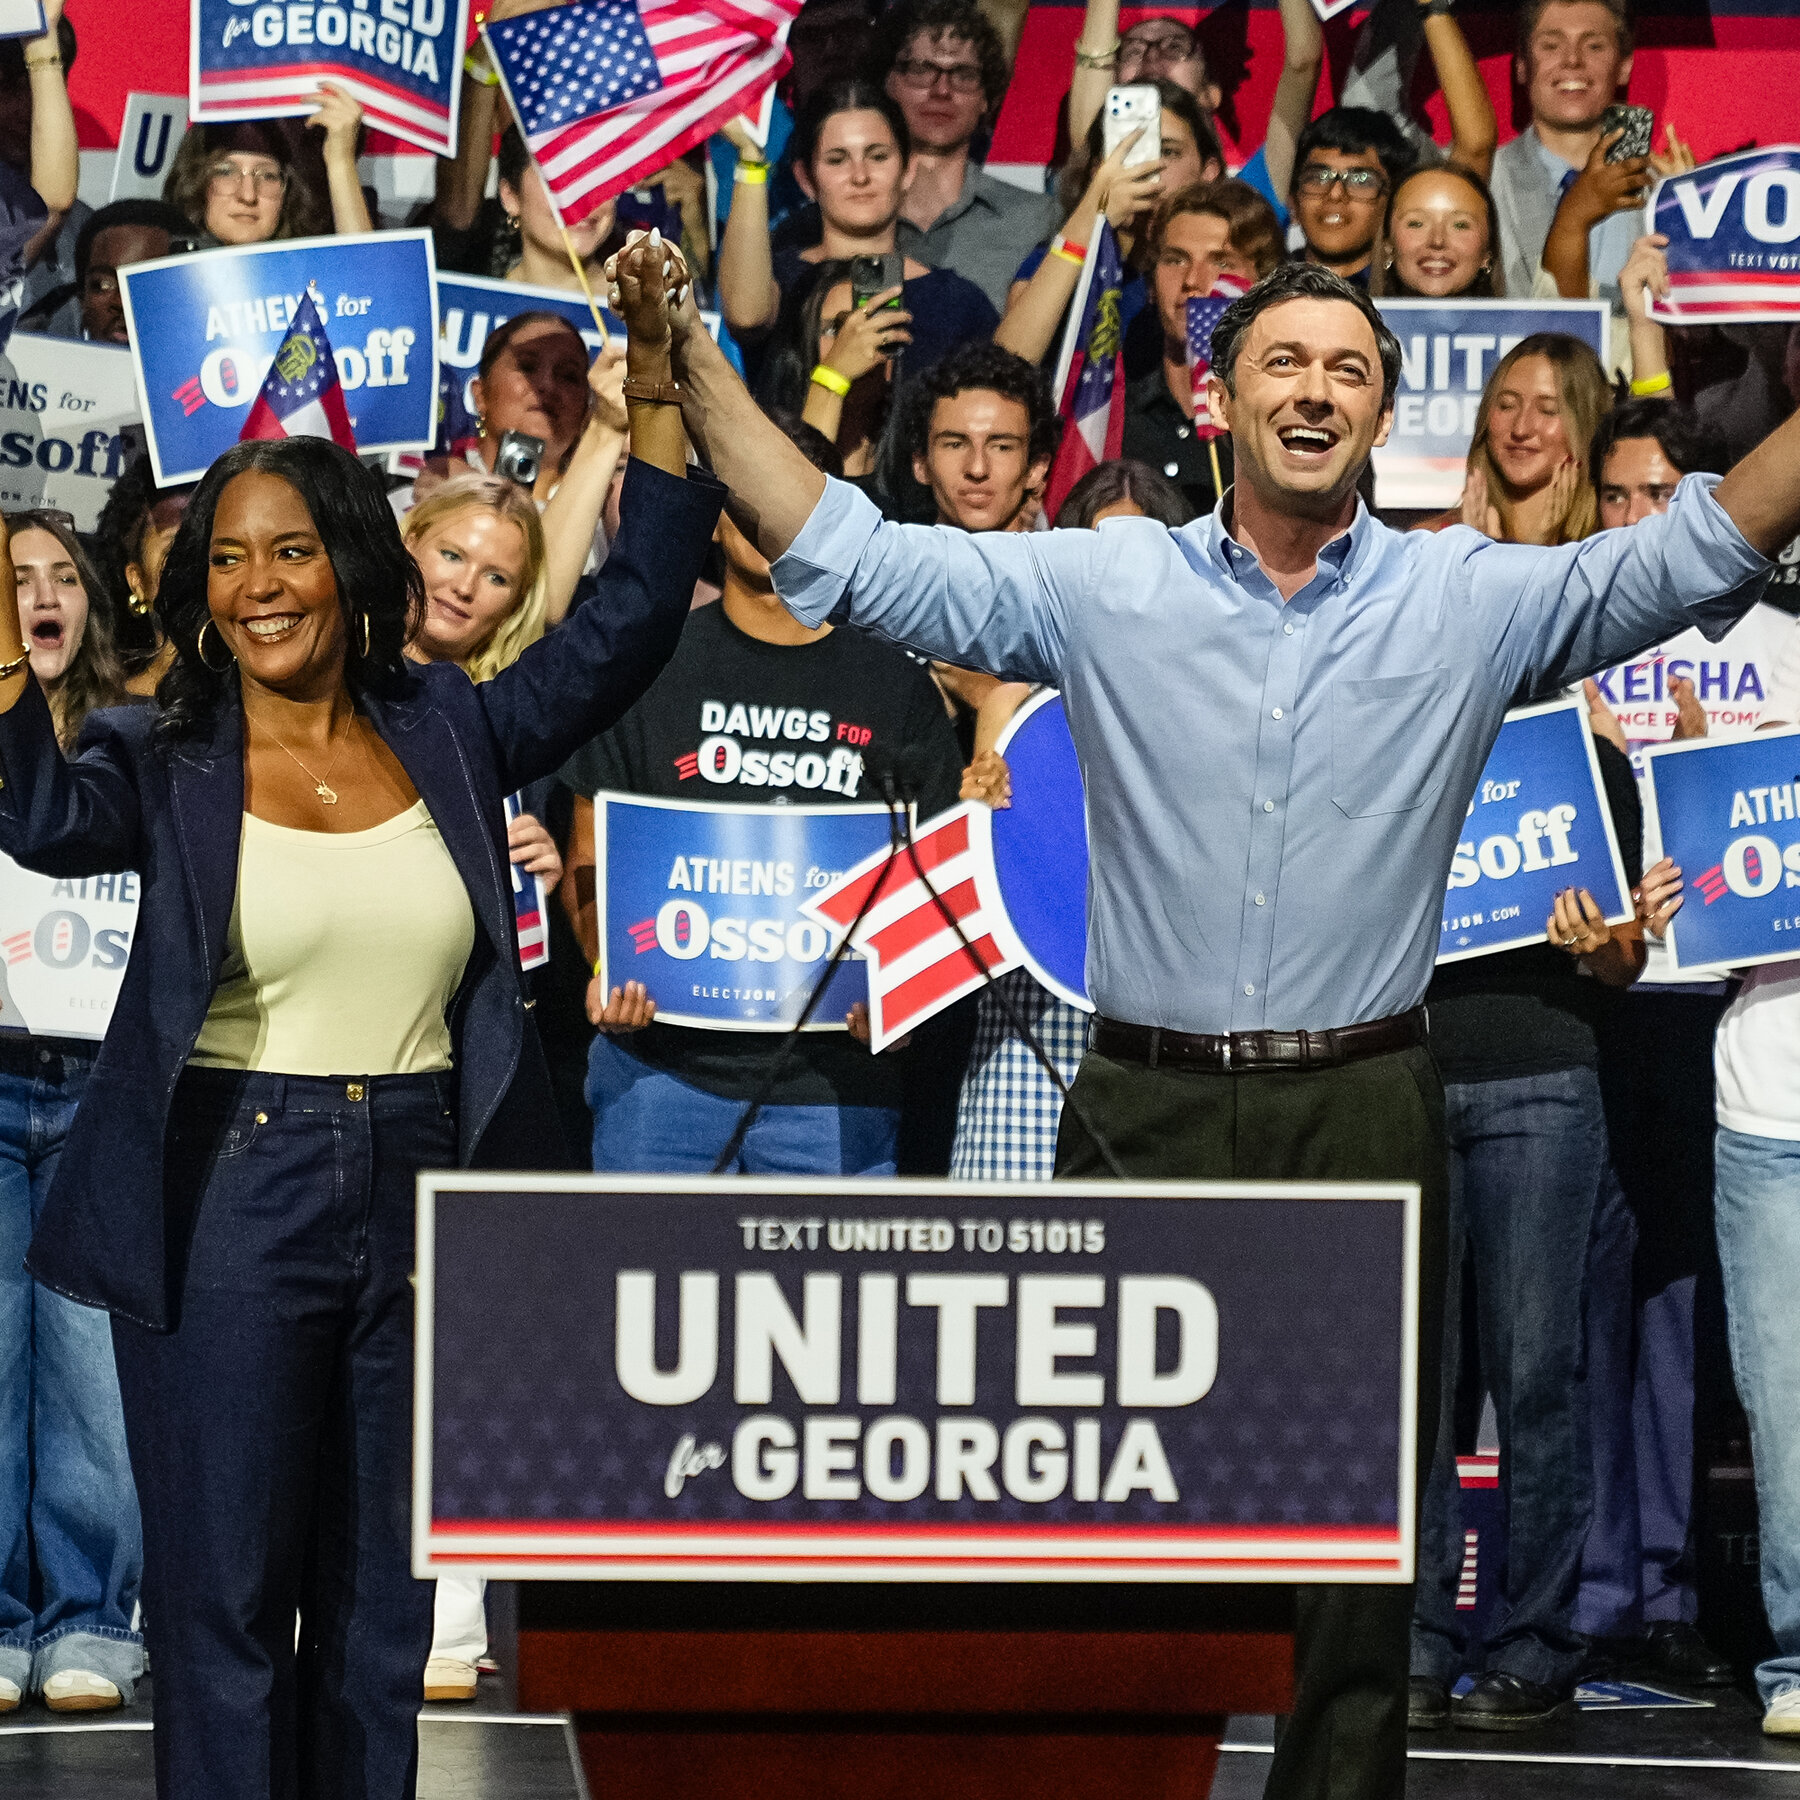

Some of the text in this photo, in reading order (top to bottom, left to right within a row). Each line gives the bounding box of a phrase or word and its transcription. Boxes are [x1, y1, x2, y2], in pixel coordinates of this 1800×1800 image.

[222, 16, 250, 48] for
[252, 4, 439, 84] GEORGIA
[1729, 252, 1800, 270] TEXT VOT
[336, 293, 371, 317] for
[200, 326, 415, 408] Ooff
[1400, 336, 1525, 391] NIT
[57, 392, 96, 413] for
[701, 701, 873, 746] DAWGS FOR
[1482, 779, 1521, 804] for
[1730, 783, 1800, 828] ATH
[667, 856, 795, 897] ATHENS
[656, 898, 867, 963] Osso
[738, 1219, 1105, 1254] TEXT UNITED TO 51015
[615, 1270, 1219, 1408] UNITED
[664, 1415, 1180, 1503] for GEORGIA
